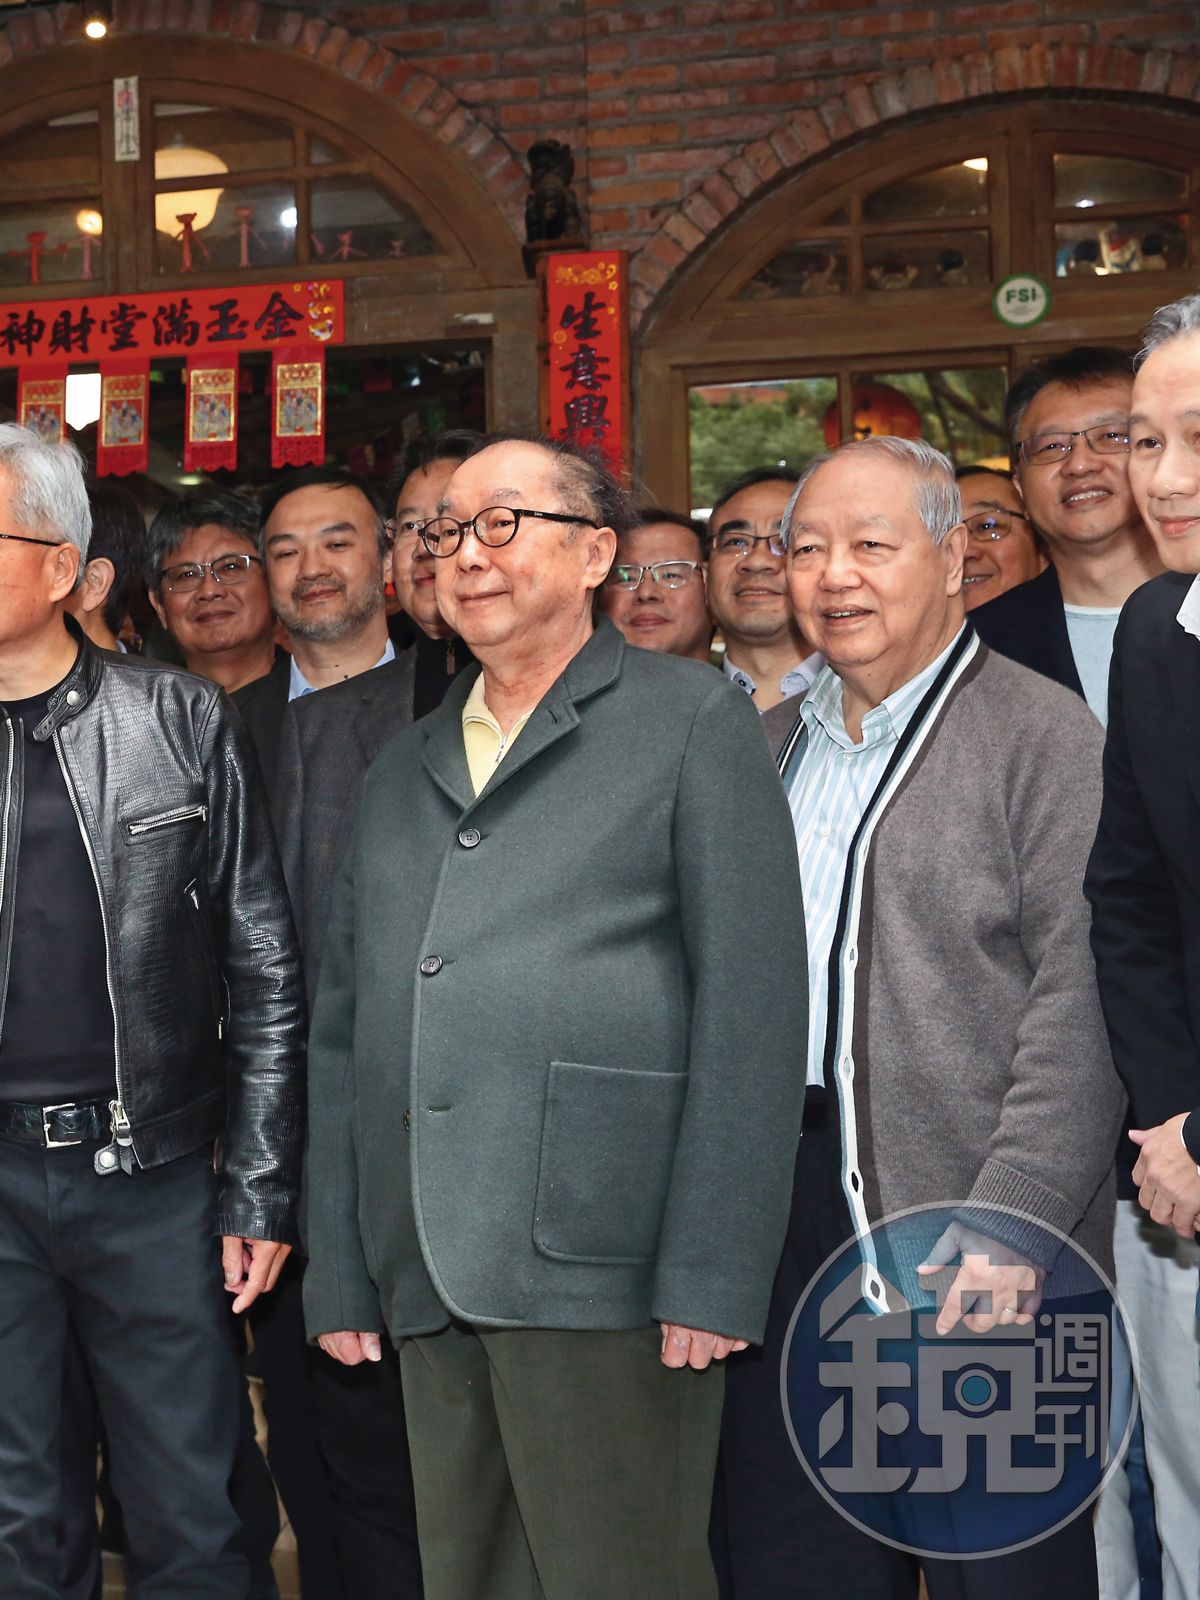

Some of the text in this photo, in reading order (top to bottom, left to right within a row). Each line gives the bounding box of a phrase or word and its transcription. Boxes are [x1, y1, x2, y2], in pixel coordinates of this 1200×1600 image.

[1006, 287, 1037, 304] FSI
[559, 291, 611, 440] 生意興
